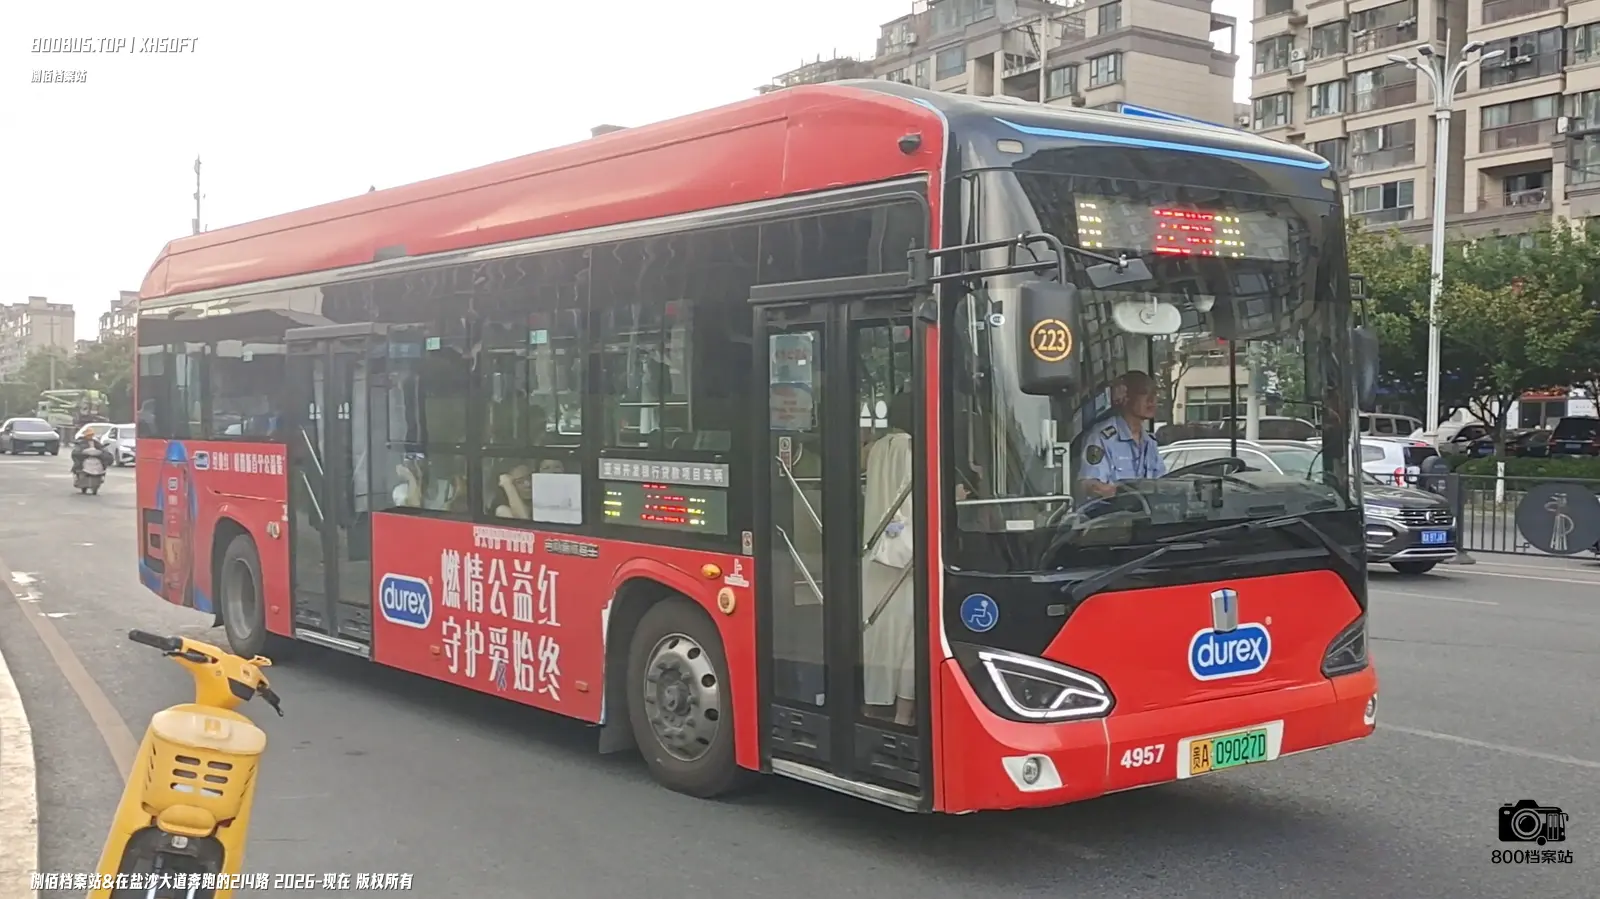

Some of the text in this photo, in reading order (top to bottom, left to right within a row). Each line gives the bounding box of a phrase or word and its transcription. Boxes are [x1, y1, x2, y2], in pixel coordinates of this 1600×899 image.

[1037, 329, 1067, 352] 223
[383, 581, 429, 621] durex
[440, 548, 562, 628] 燃情公益红
[441, 614, 562, 702] 守护爱始终
[1196, 635, 1265, 668] durex
[1120, 743, 1166, 769] 4957
